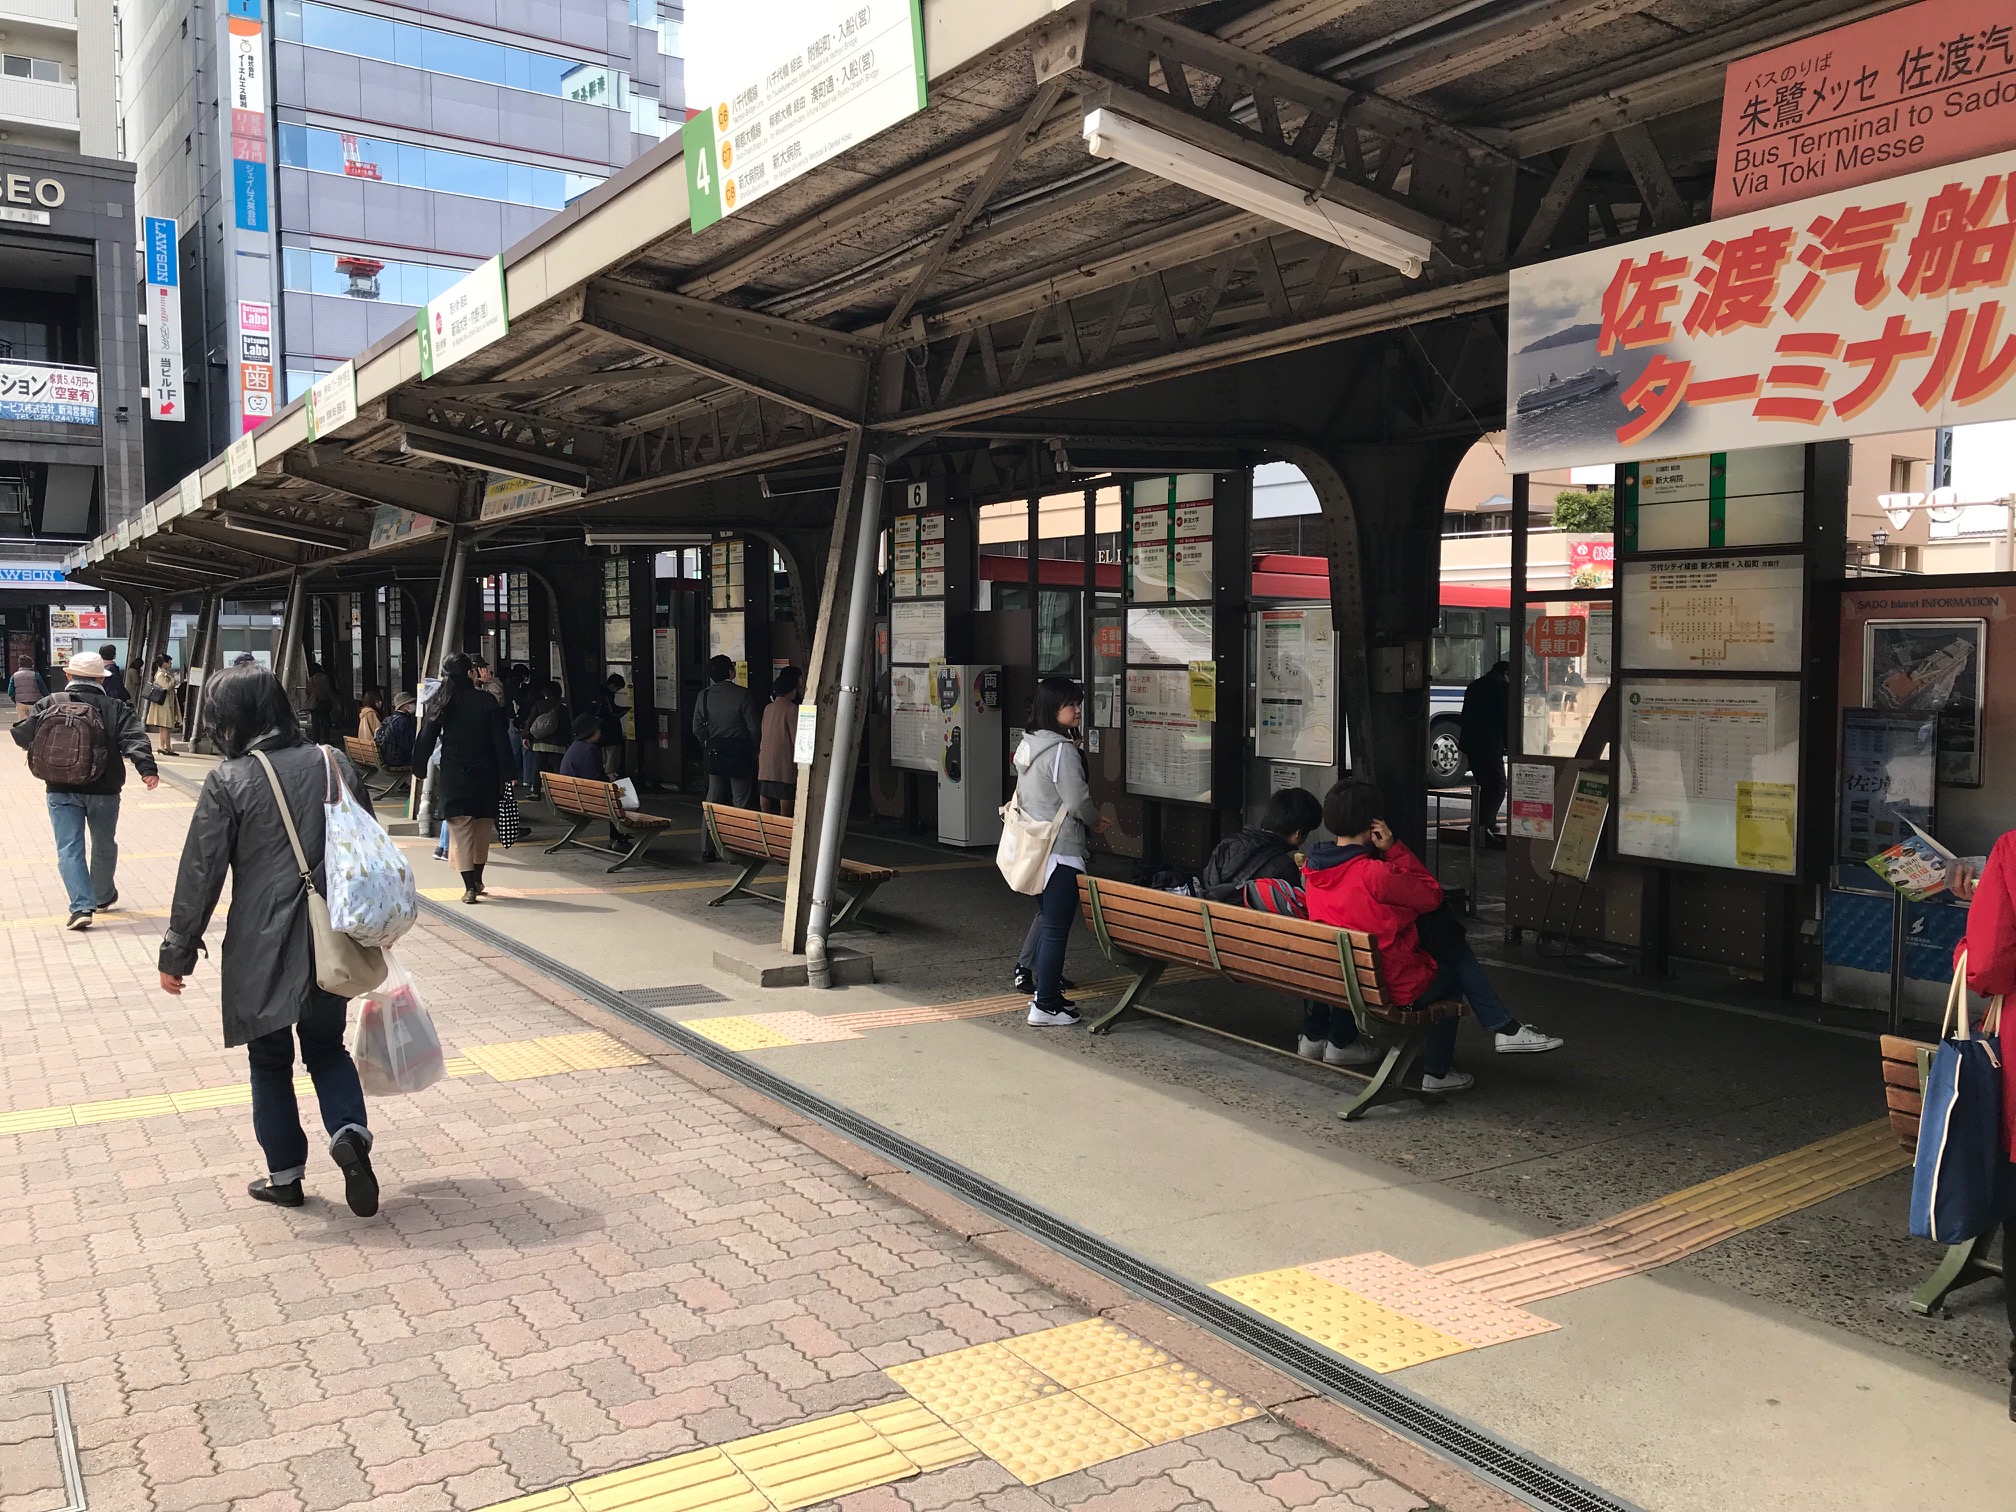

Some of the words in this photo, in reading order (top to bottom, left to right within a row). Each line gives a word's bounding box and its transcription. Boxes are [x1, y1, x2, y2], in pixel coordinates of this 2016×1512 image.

[1738, 65, 1879, 137] 朱鷺メッセ
[1897, 25, 2015, 93] 佐渡汽
[1745, 52, 1833, 92] バスのりば
[718, 109, 729, 125] C6
[1734, 145, 1779, 172] Bus
[1788, 109, 1899, 155] Terminal
[1909, 105, 1934, 127] to
[1944, 81, 2016, 117] Sado
[722, 147, 731, 162] C7
[772, 140, 802, 170] 新大病院
[1733, 173, 1768, 197] Via
[1778, 154, 1826, 186] Toki
[1835, 135, 1925, 171] Messe
[697, 147, 711, 195] 4
[0, 174, 65, 207] EO
[726, 187, 735, 201] C8
[155, 221, 168, 283] LAWSON
[1597, 174, 2016, 356] 佐渡汽船
[243, 312, 267, 325] Labo
[244, 343, 268, 357] Labo
[422, 329, 429, 360] 5
[244, 365, 270, 391] 歯
[1616, 301, 2016, 448] ターミナル
[157, 389, 177, 400] 1F
[0, 402, 55, 415] ービス株式会社
[309, 405, 313, 428] 6
[1655, 474, 1684, 484] 新大病院
[913, 485, 921, 506] 6
[1858, 600, 1888, 610] SADO
[1891, 599, 1918, 609] Island
[1921, 597, 1999, 609] INFORMATION
[1541, 619, 1581, 635] 4番線
[1540, 638, 1579, 654] 乗車口
[984, 673, 998, 706] 両替
